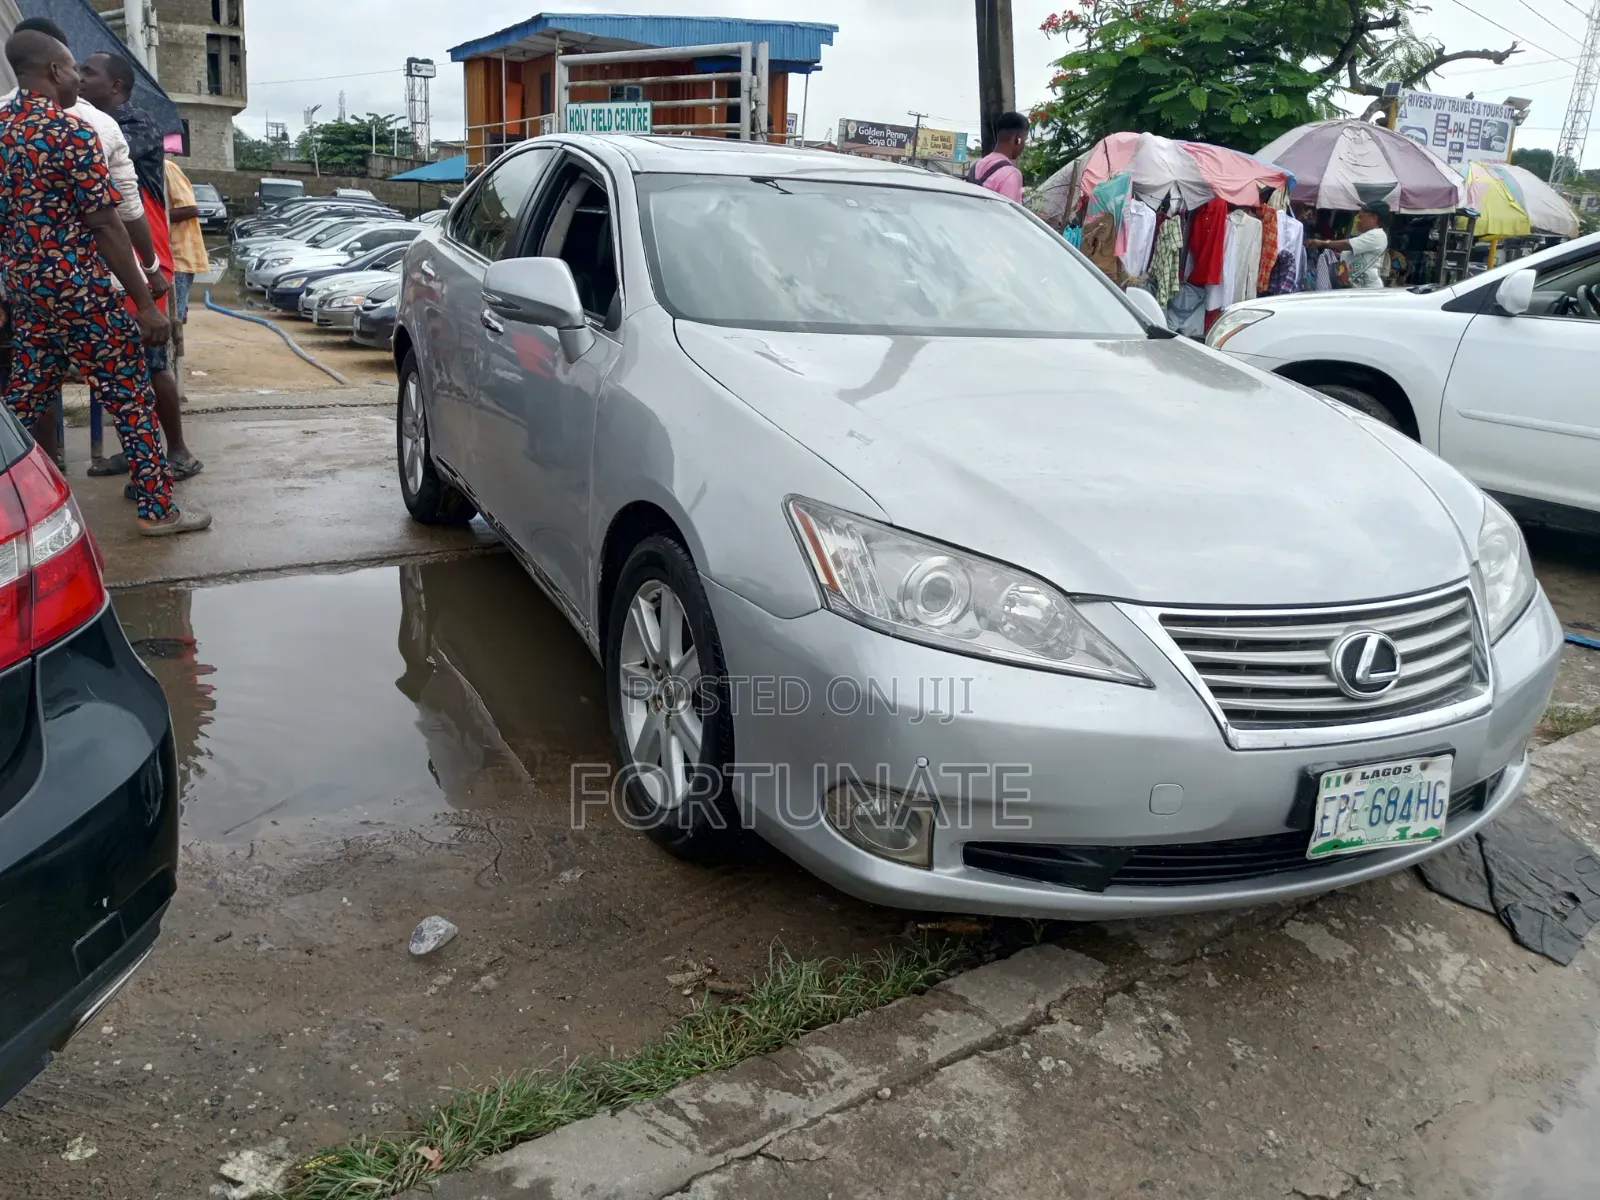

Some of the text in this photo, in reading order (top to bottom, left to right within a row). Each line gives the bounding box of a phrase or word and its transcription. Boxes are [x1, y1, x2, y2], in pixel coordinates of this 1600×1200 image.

[1408, 94, 1432, 109] RIVERS
[1433, 98, 1447, 111] JOY
[1448, 100, 1475, 115] TRAVELS
[1476, 104, 1481, 115] &
[1482, 105, 1503, 118] TOURS
[569, 108, 648, 132] HOLY FIELD CENTRE
[858, 126, 908, 142] Golden Penny
[1452, 121, 1465, 138] PH
[867, 136, 898, 148] Soya Oil
[1360, 764, 1413, 780] LAGOS
